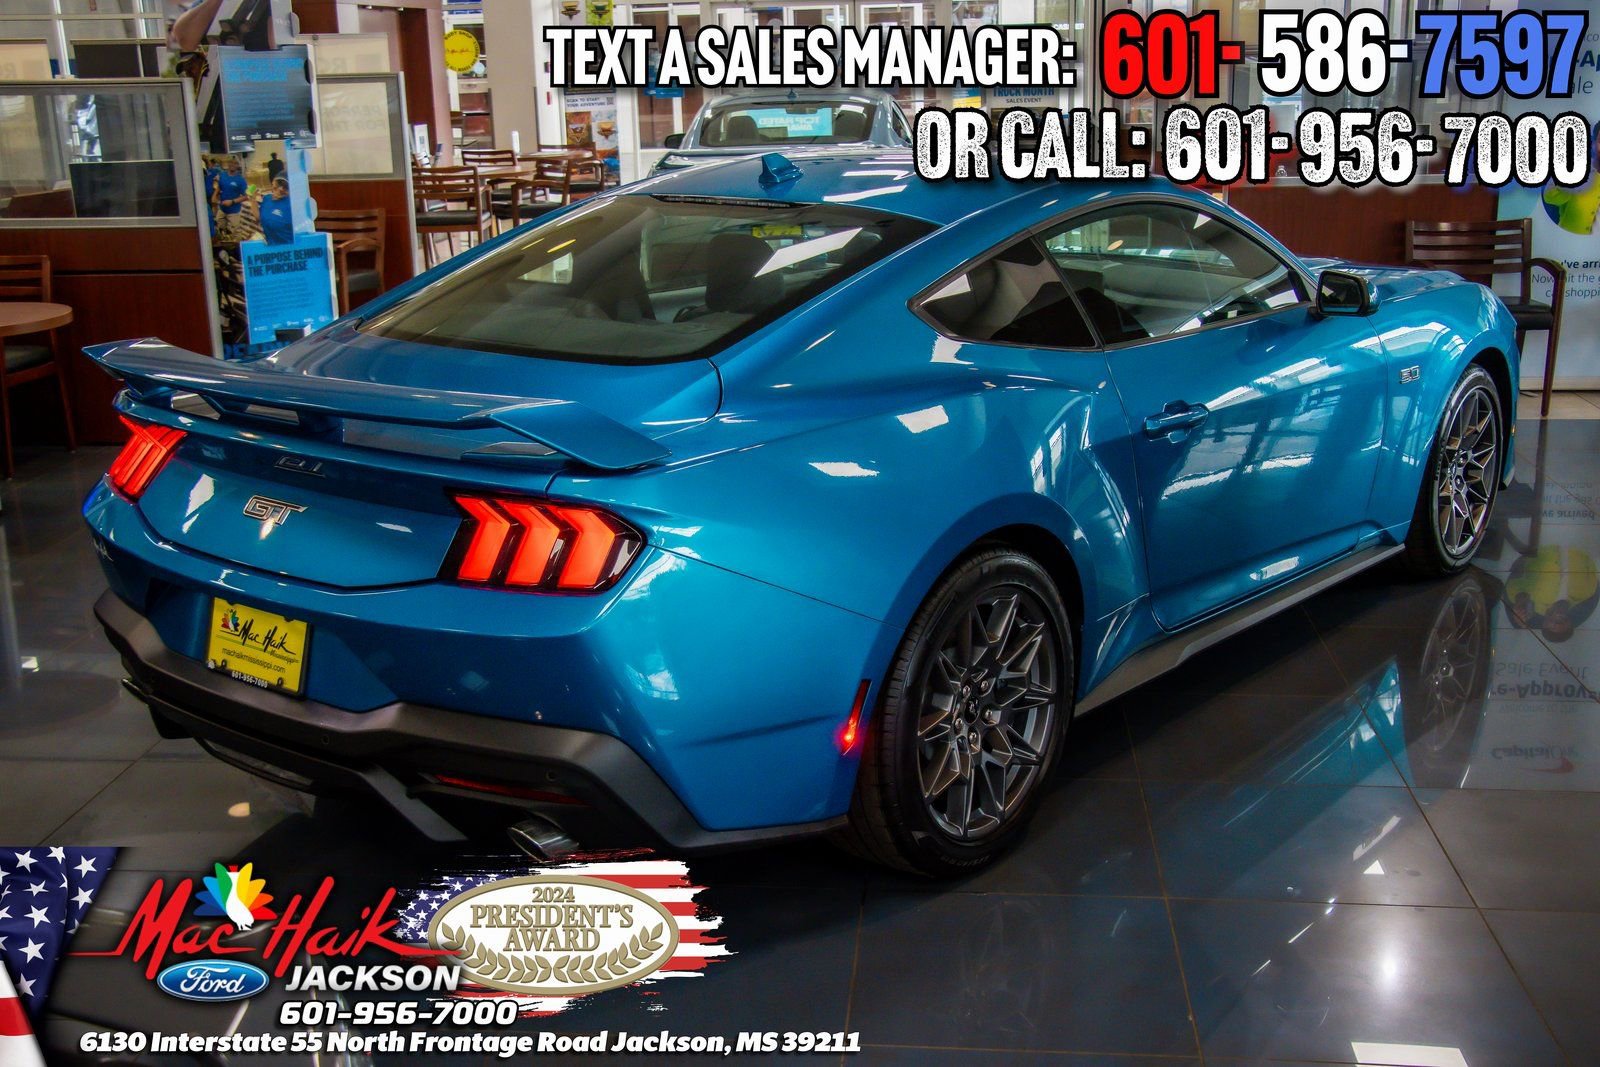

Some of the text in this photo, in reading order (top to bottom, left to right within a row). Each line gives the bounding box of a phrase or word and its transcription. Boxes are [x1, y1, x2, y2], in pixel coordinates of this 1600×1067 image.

[1023, 86, 1055, 97] MONTH
[247, 247, 323, 266] A PURPOSE BEHIND
[248, 260, 308, 278] THE PURCHASE
[1578, 273, 1595, 283] the
[243, 494, 309, 526] GT
[238, 619, 294, 654] Mac Haik
[231, 670, 269, 689] 601-956-7000
